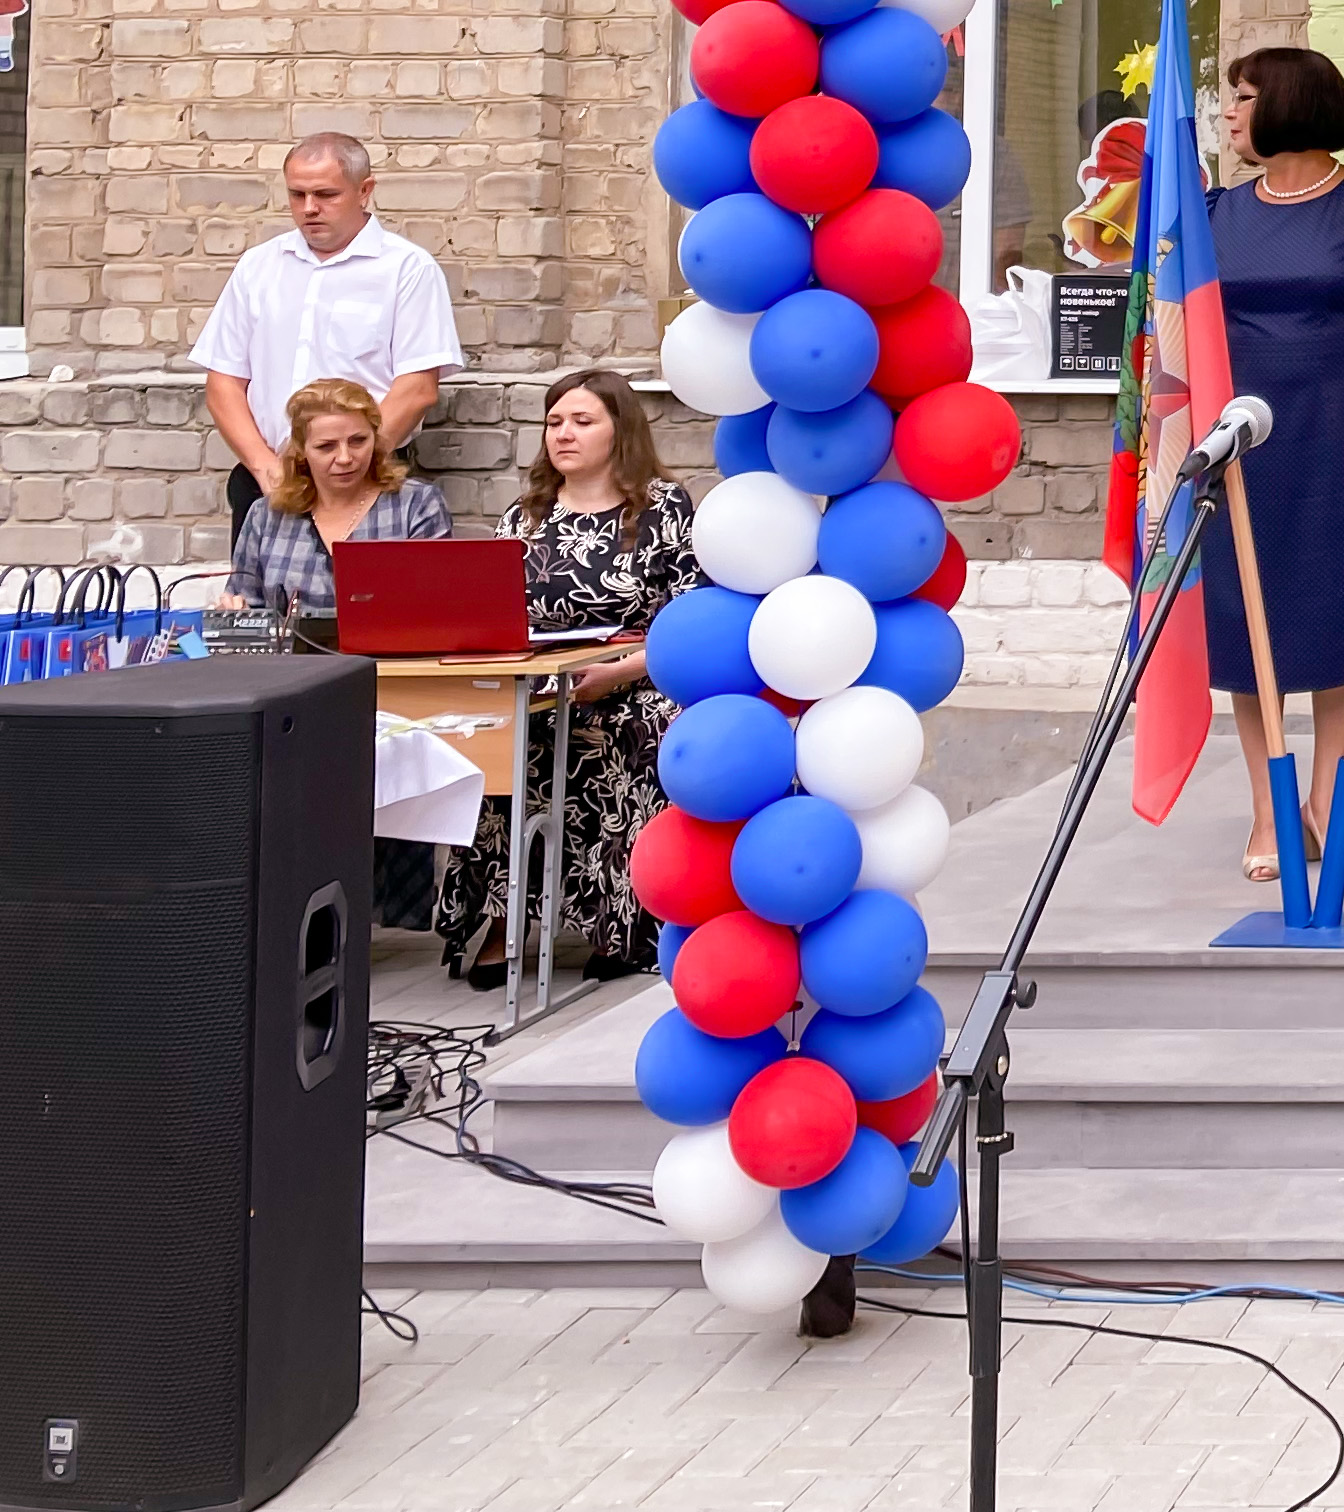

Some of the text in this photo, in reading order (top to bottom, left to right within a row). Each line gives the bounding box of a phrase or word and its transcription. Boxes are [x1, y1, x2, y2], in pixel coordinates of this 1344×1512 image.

[1060, 286, 1128, 297] Всегда что-то
[1060, 297, 1116, 307] новенькое!
